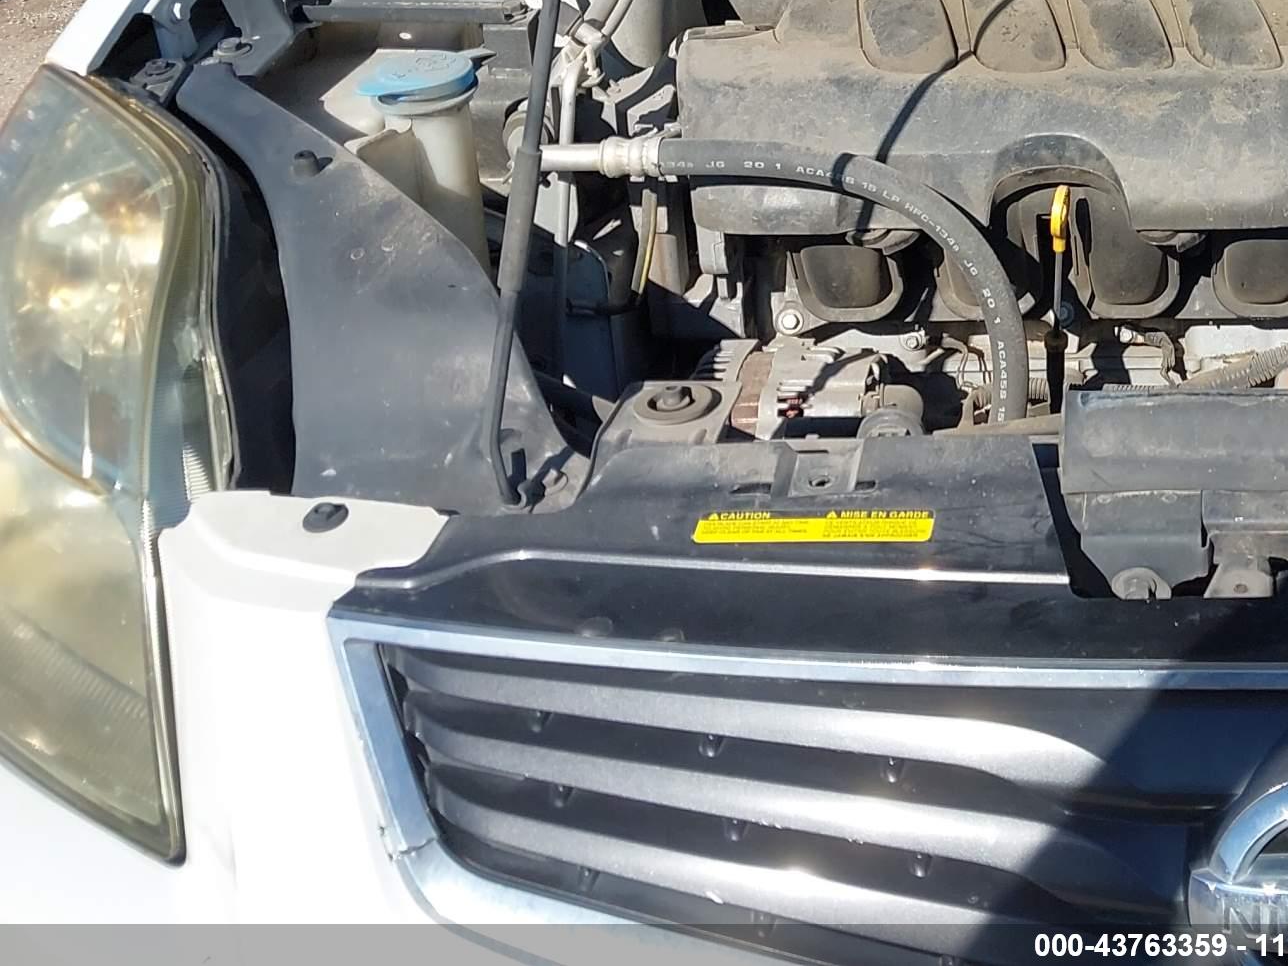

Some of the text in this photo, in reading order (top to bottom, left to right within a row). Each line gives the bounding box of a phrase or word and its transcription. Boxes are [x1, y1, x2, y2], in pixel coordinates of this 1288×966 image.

[743, 160, 765, 169] 20
[720, 511, 771, 521] CAUTION
[840, 510, 930, 519] MISE EN GARDE
